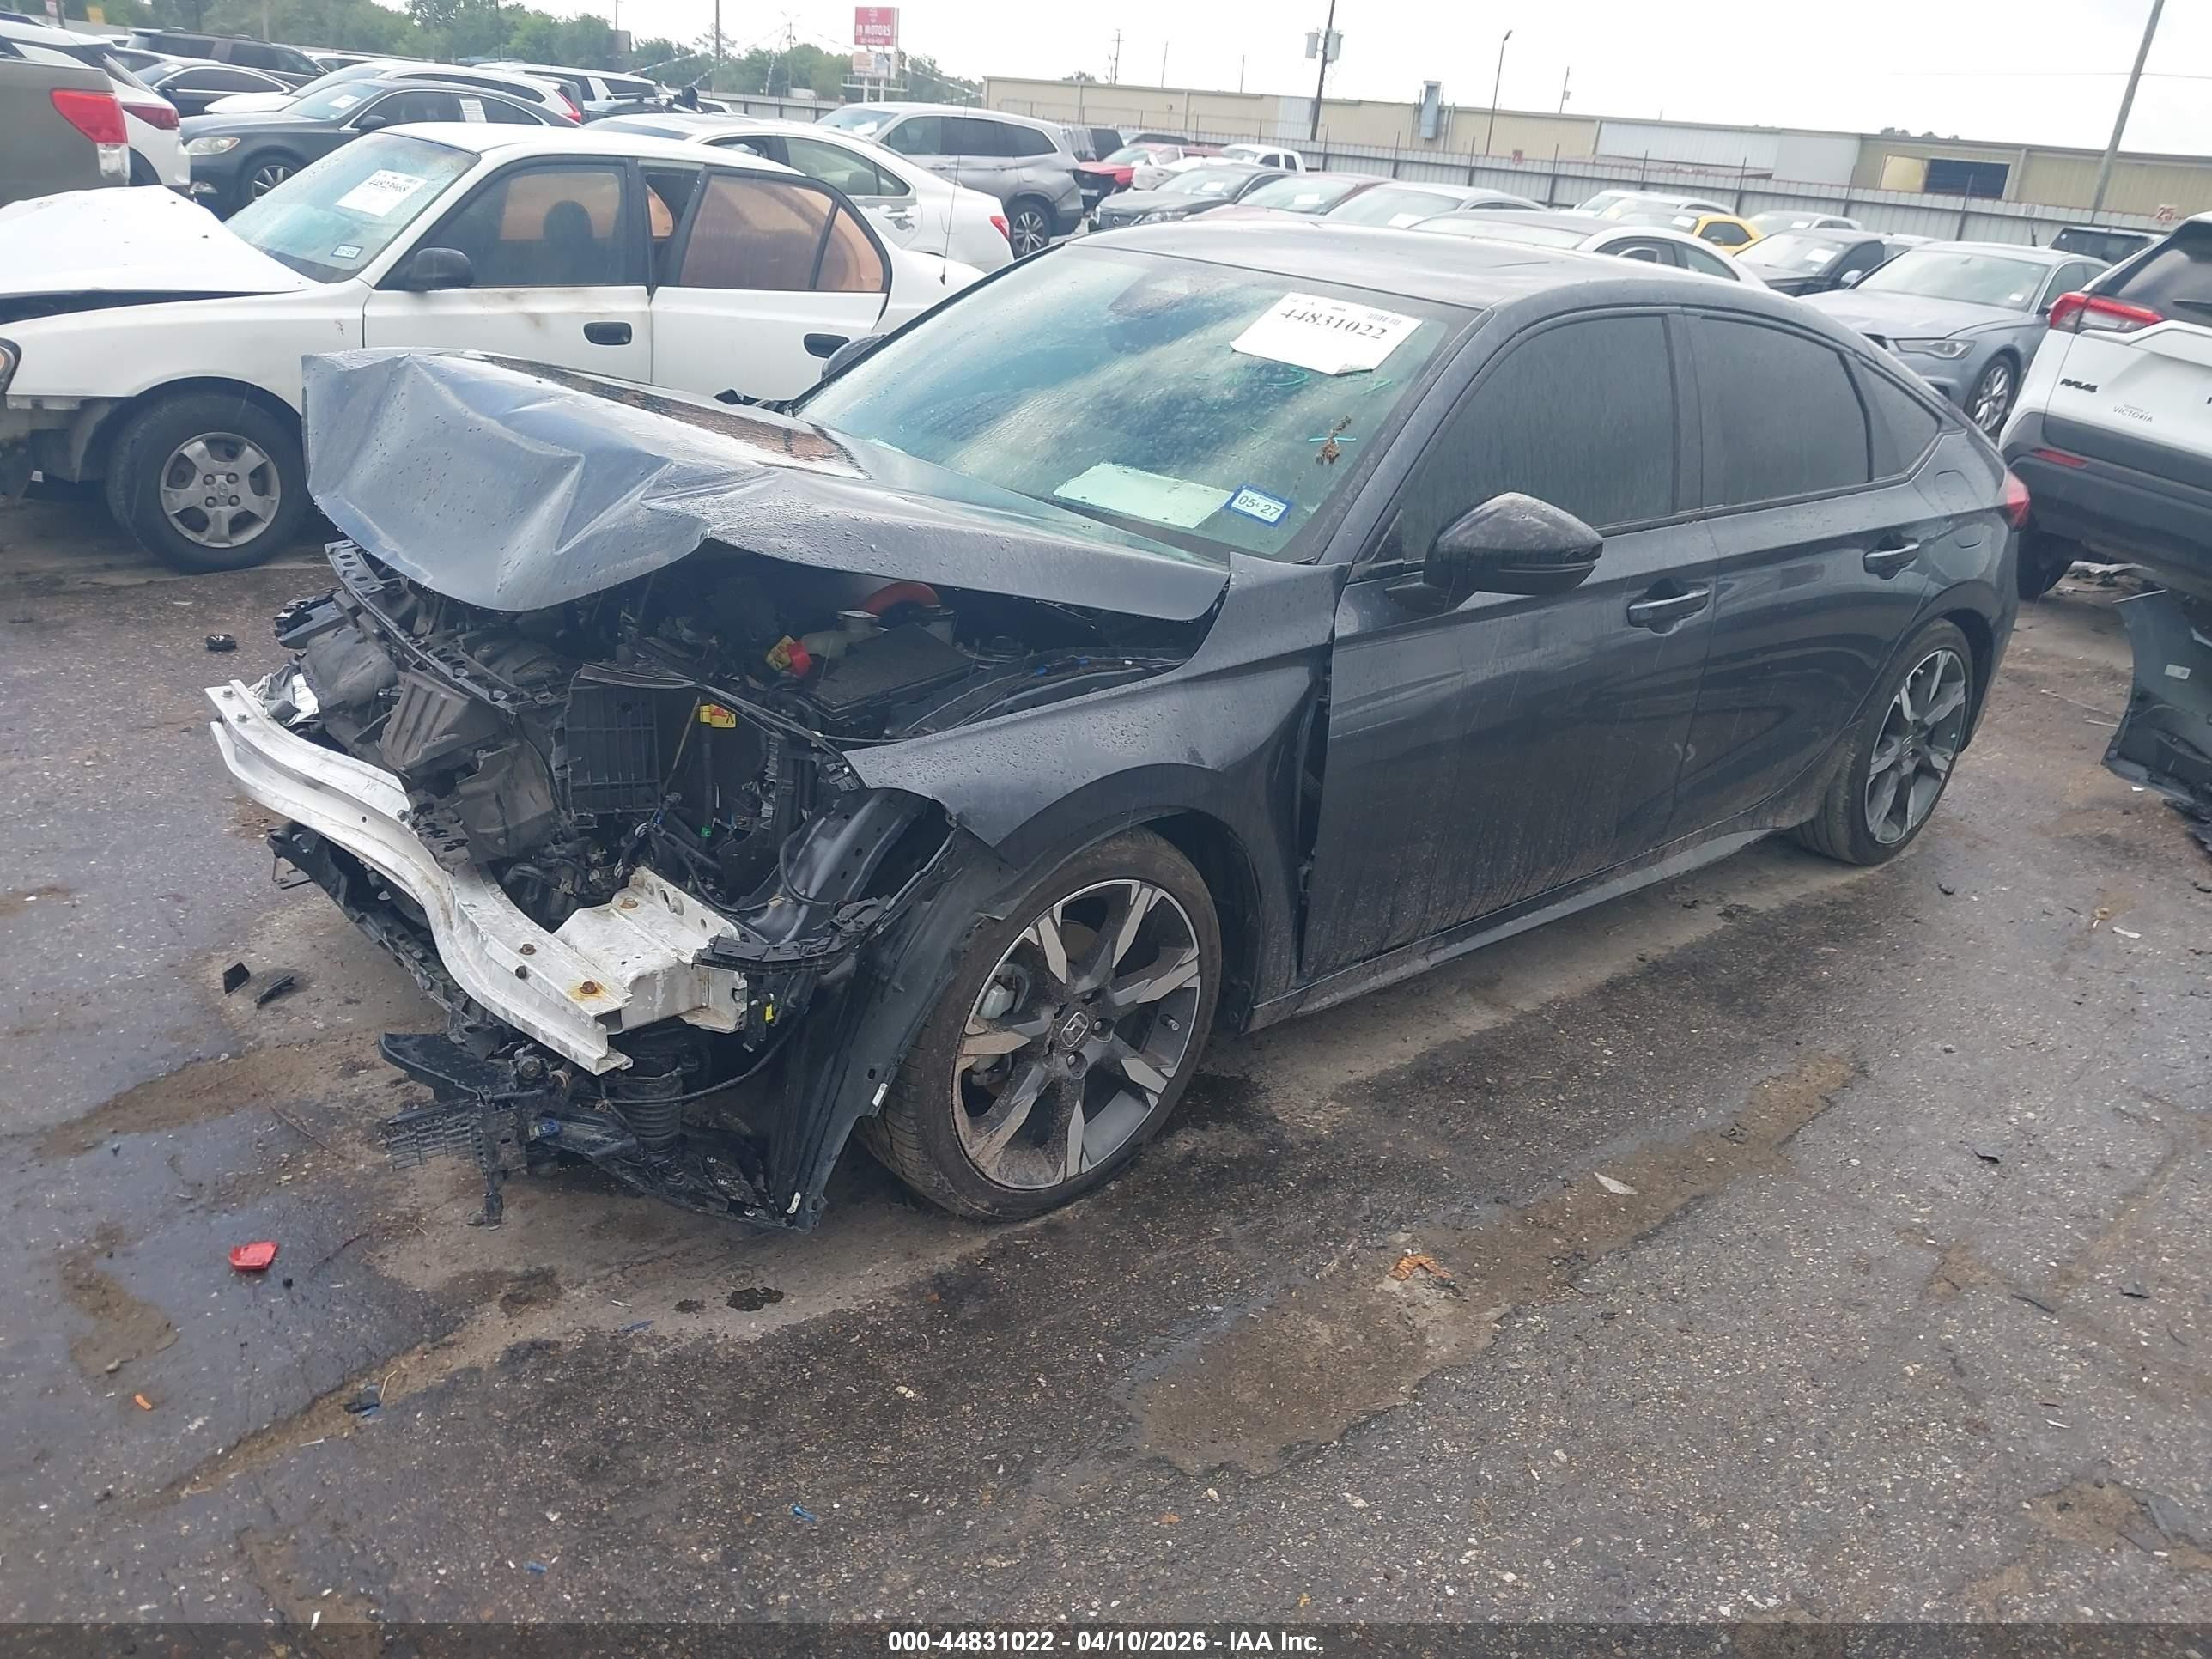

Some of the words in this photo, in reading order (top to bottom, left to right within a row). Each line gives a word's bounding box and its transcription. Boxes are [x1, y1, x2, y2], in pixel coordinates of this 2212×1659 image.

[1280, 308, 1388, 340] 44831022
[2113, 405, 2154, 423] VICTORIA
[1238, 495, 1258, 508] 05
[1260, 504, 1281, 517] 27
